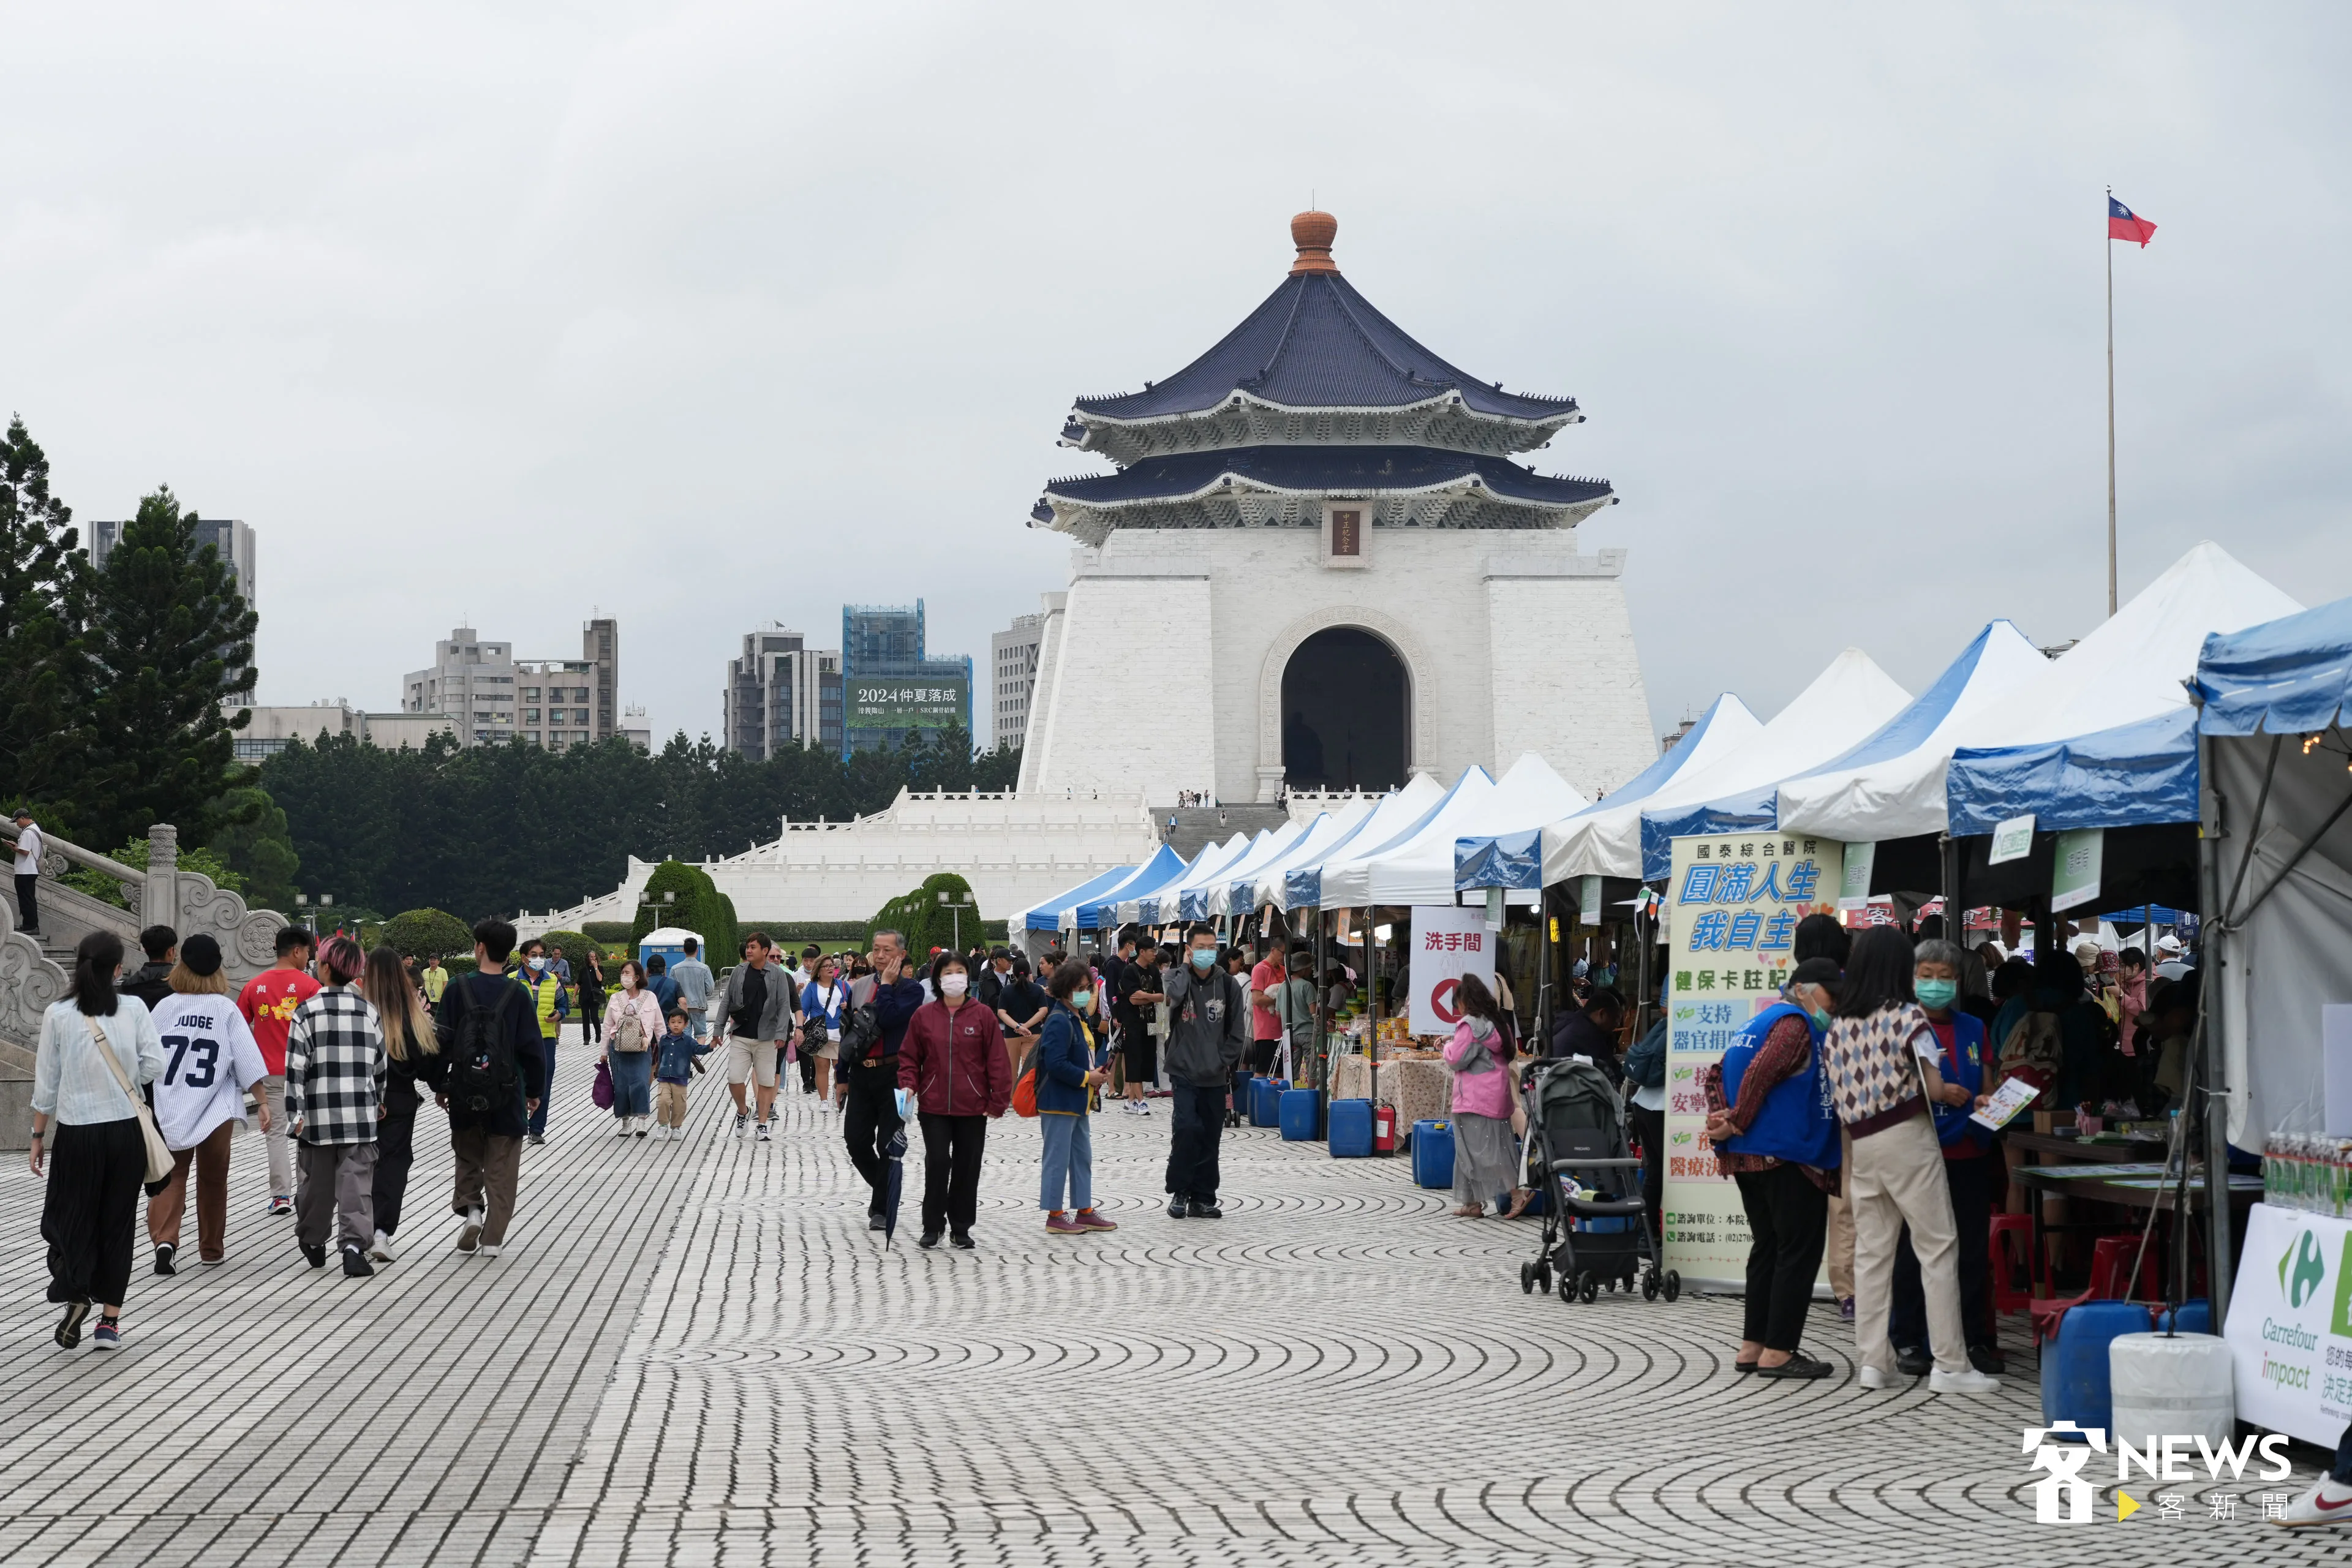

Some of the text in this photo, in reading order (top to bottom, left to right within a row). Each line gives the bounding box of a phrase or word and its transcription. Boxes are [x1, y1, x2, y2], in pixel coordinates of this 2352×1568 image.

[1342, 513, 1351, 552] 中正紀念堂
[858, 688, 956, 703] 2024仲夏落成
[1697, 840, 1817, 859] 國泰綜合醫院
[1678, 861, 1821, 906] 圓滿人生
[1689, 908, 1797, 952] 我自主
[1855, 912, 1863, 927] 媽媽
[1425, 932, 1482, 952] 洗手間
[1675, 969, 1796, 991] 健保卡註記
[175, 1015, 214, 1030] JUDGE
[1696, 1004, 1732, 1025] 支持
[160, 1035, 220, 1088] 73
[2263, 1317, 2318, 1351] Carrefour
[2262, 1351, 2310, 1390] impact
